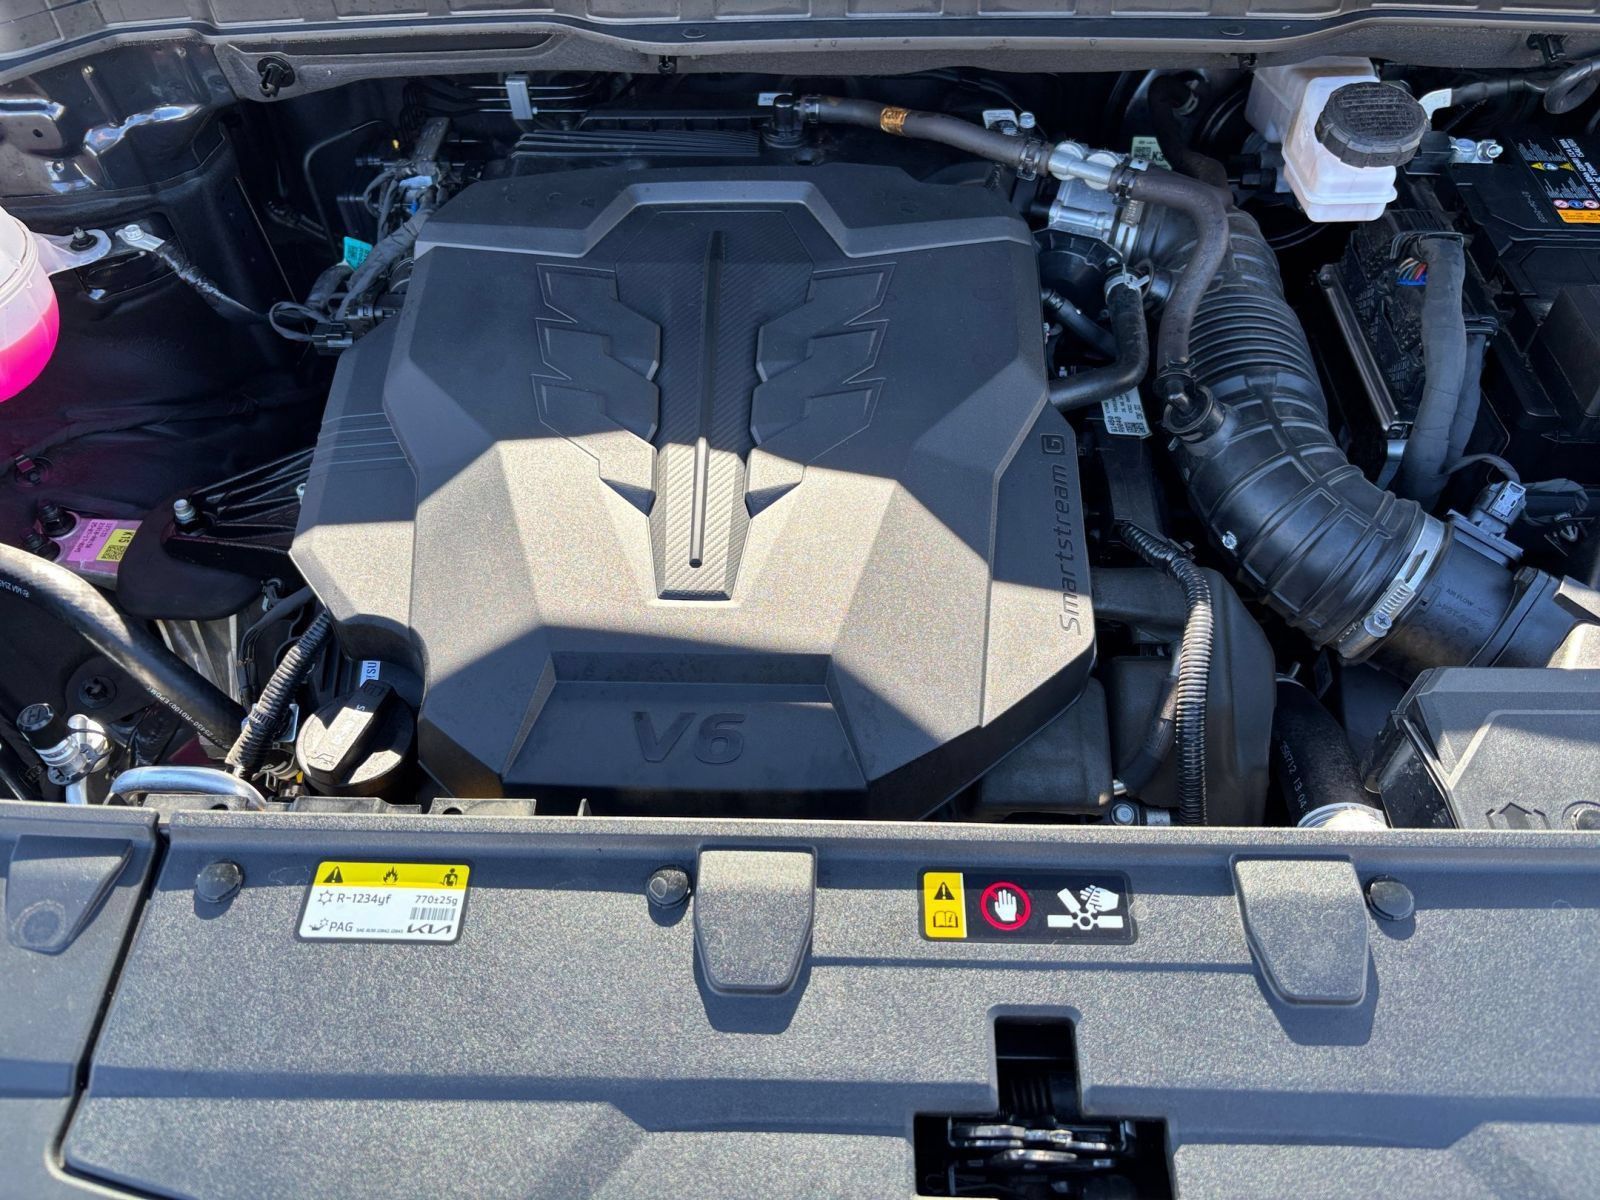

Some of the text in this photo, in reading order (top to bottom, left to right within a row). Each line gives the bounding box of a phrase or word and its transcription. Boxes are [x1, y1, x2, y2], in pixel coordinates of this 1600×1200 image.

[1052, 464, 1081, 636] Smartstream
[631, 711, 745, 764] V6
[336, 893, 458, 906] R-1234yf 770±25g
[328, 921, 354, 933] PAG
[407, 923, 452, 934] KIA
